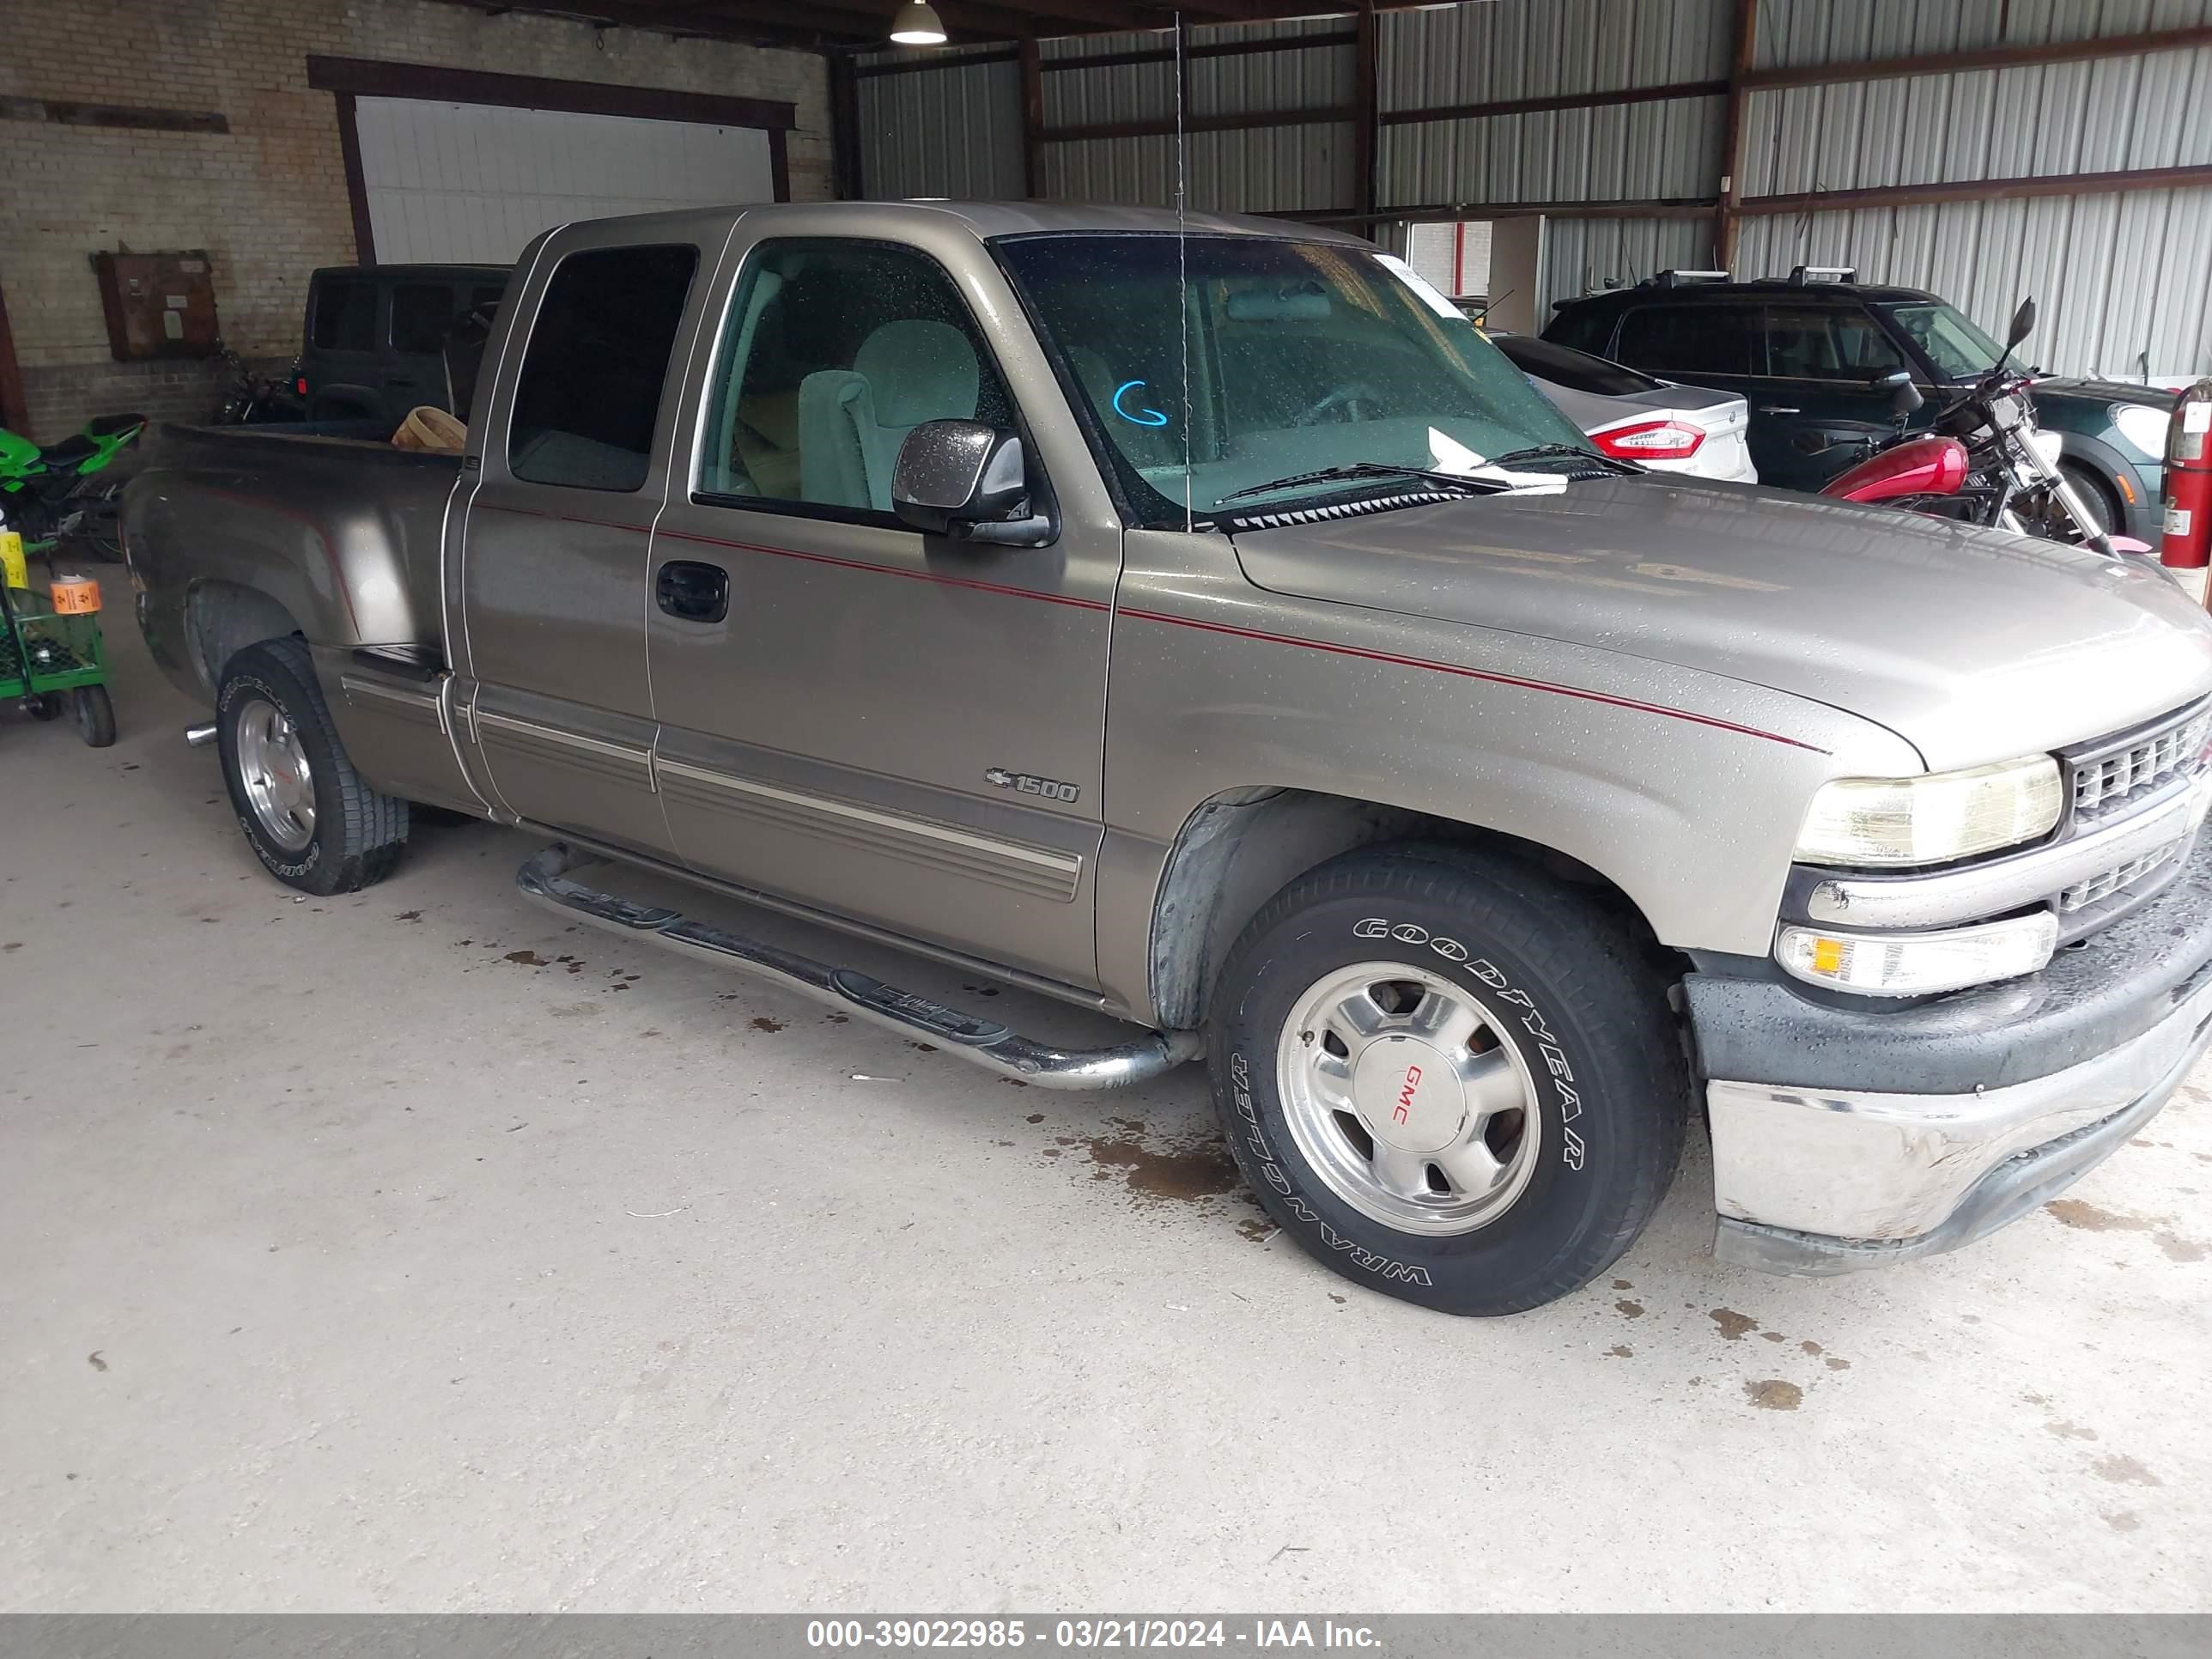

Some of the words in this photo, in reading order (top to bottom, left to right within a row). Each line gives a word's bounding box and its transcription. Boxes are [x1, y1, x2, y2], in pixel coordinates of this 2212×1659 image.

[1016, 775, 1080, 803] 1500
[1352, 917, 1587, 1172] GOODYEAR
[1392, 1065, 1423, 1126] GMC
[1228, 1050, 1434, 1288] WRANGLER
